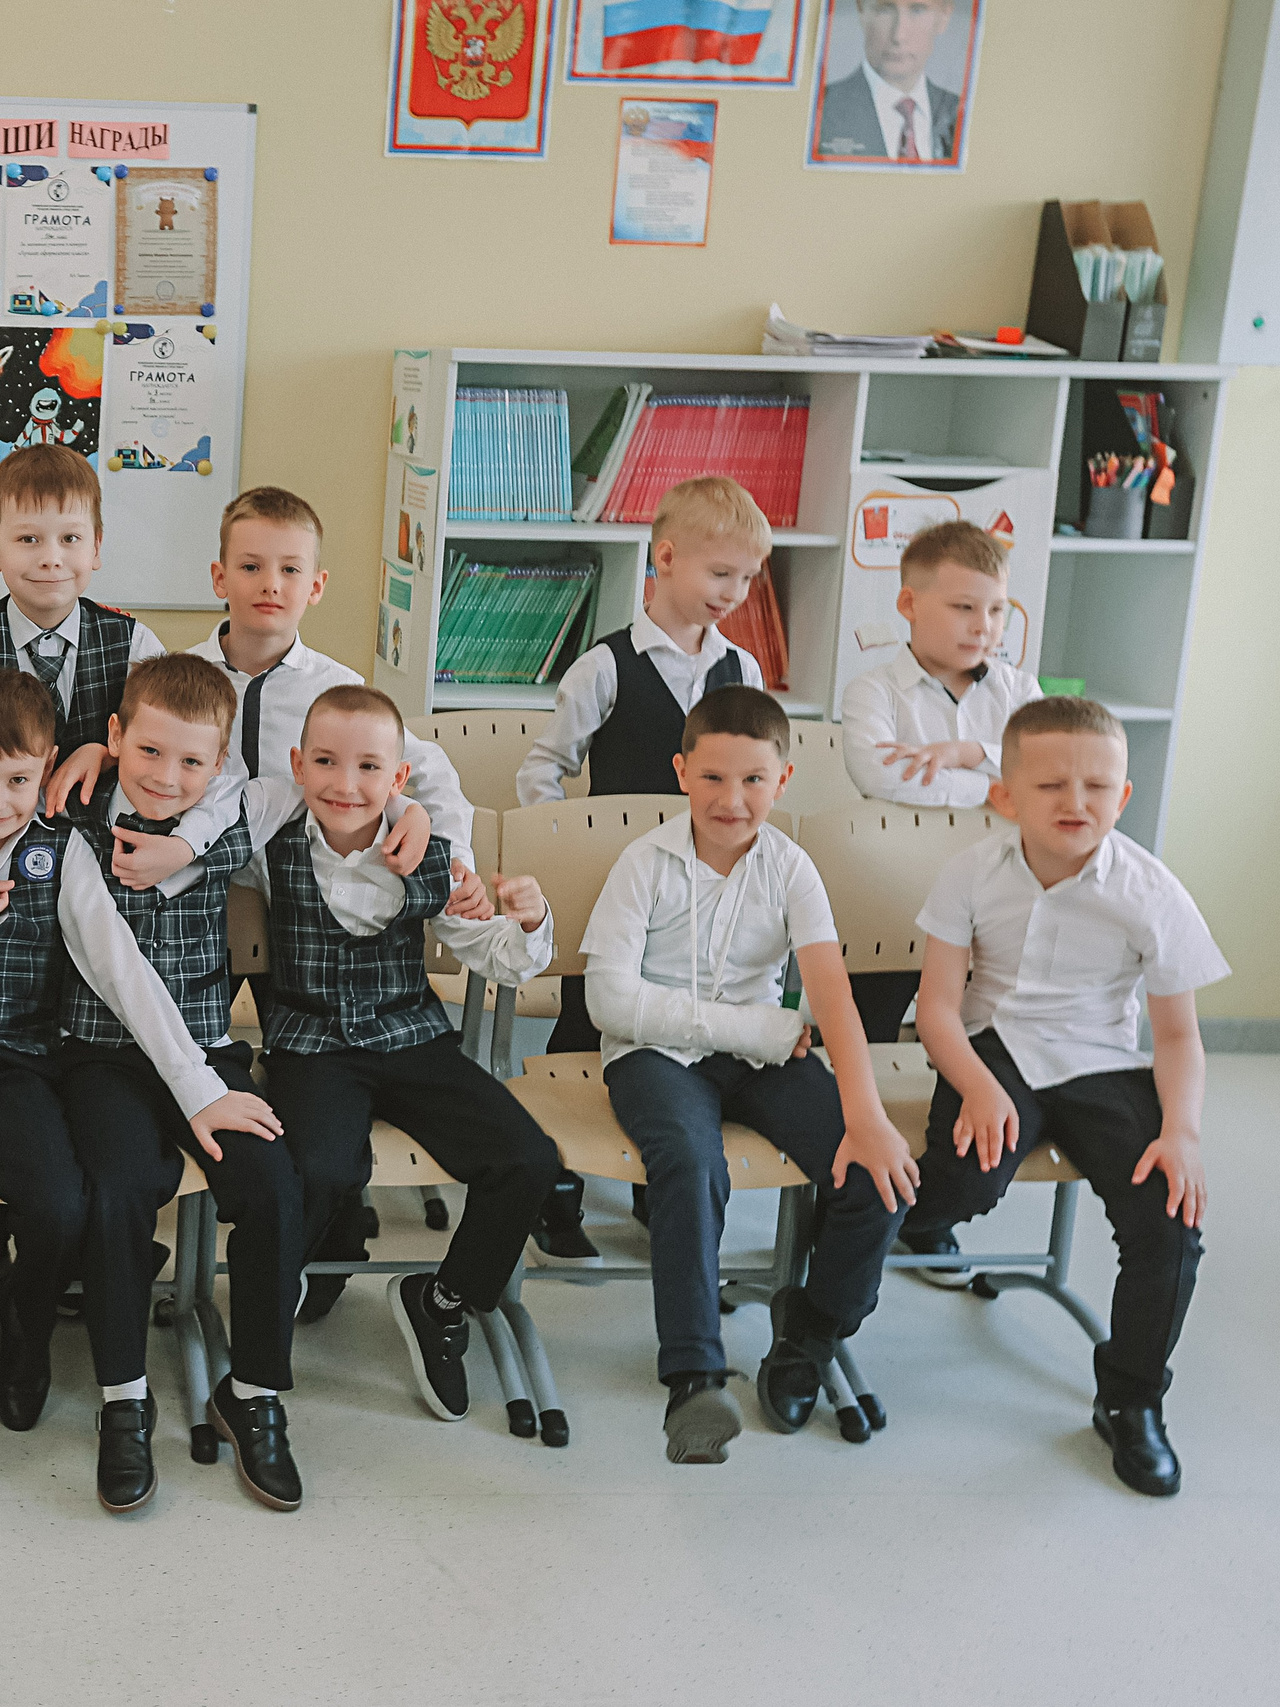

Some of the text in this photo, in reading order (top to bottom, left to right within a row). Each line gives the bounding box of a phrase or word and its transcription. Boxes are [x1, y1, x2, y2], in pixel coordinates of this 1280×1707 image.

[69, 121, 168, 152] НАГРАДЫ
[24, 214, 91, 226] ГРАМОТА
[129, 370, 196, 383] ГРАМОТА
